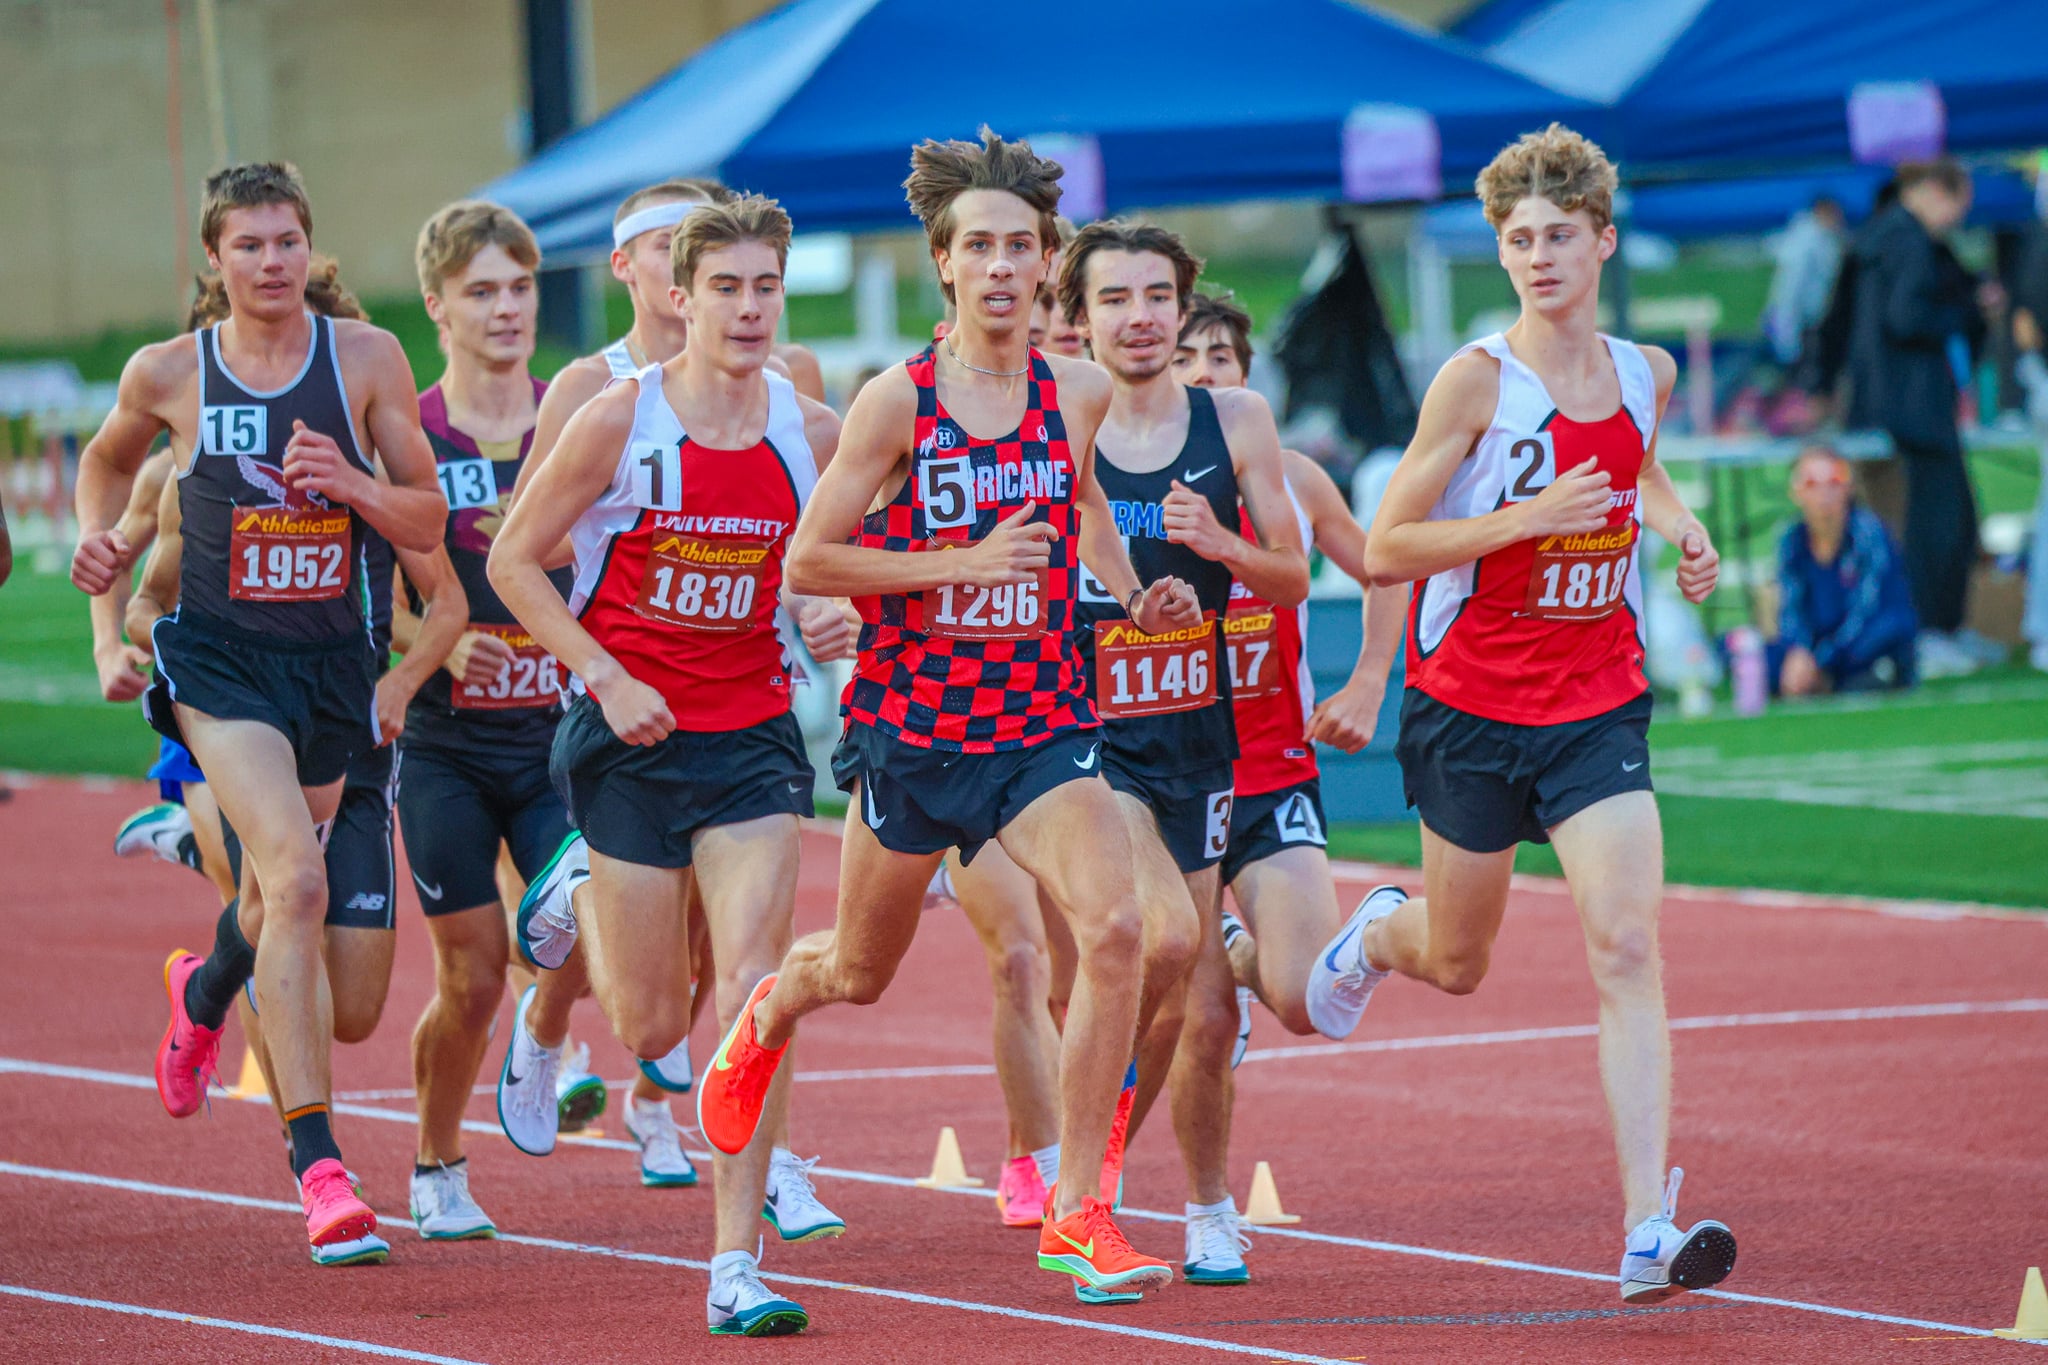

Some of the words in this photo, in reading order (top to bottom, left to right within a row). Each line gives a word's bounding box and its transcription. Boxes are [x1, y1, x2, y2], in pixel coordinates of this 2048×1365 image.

[207, 409, 257, 452] 15
[439, 463, 489, 507] 13
[639, 449, 664, 507] 1
[928, 462, 966, 523] 5
[1510, 438, 1551, 497] 2
[655, 513, 789, 537] UNIVERSITY
[241, 543, 343, 590] 1952
[649, 566, 756, 620] 1830
[1537, 555, 1629, 609] 1818
[935, 580, 1039, 627] 1296
[1110, 649, 1208, 704] 1146
[1211, 794, 1232, 852] 3
[1285, 794, 1315, 838] 4
